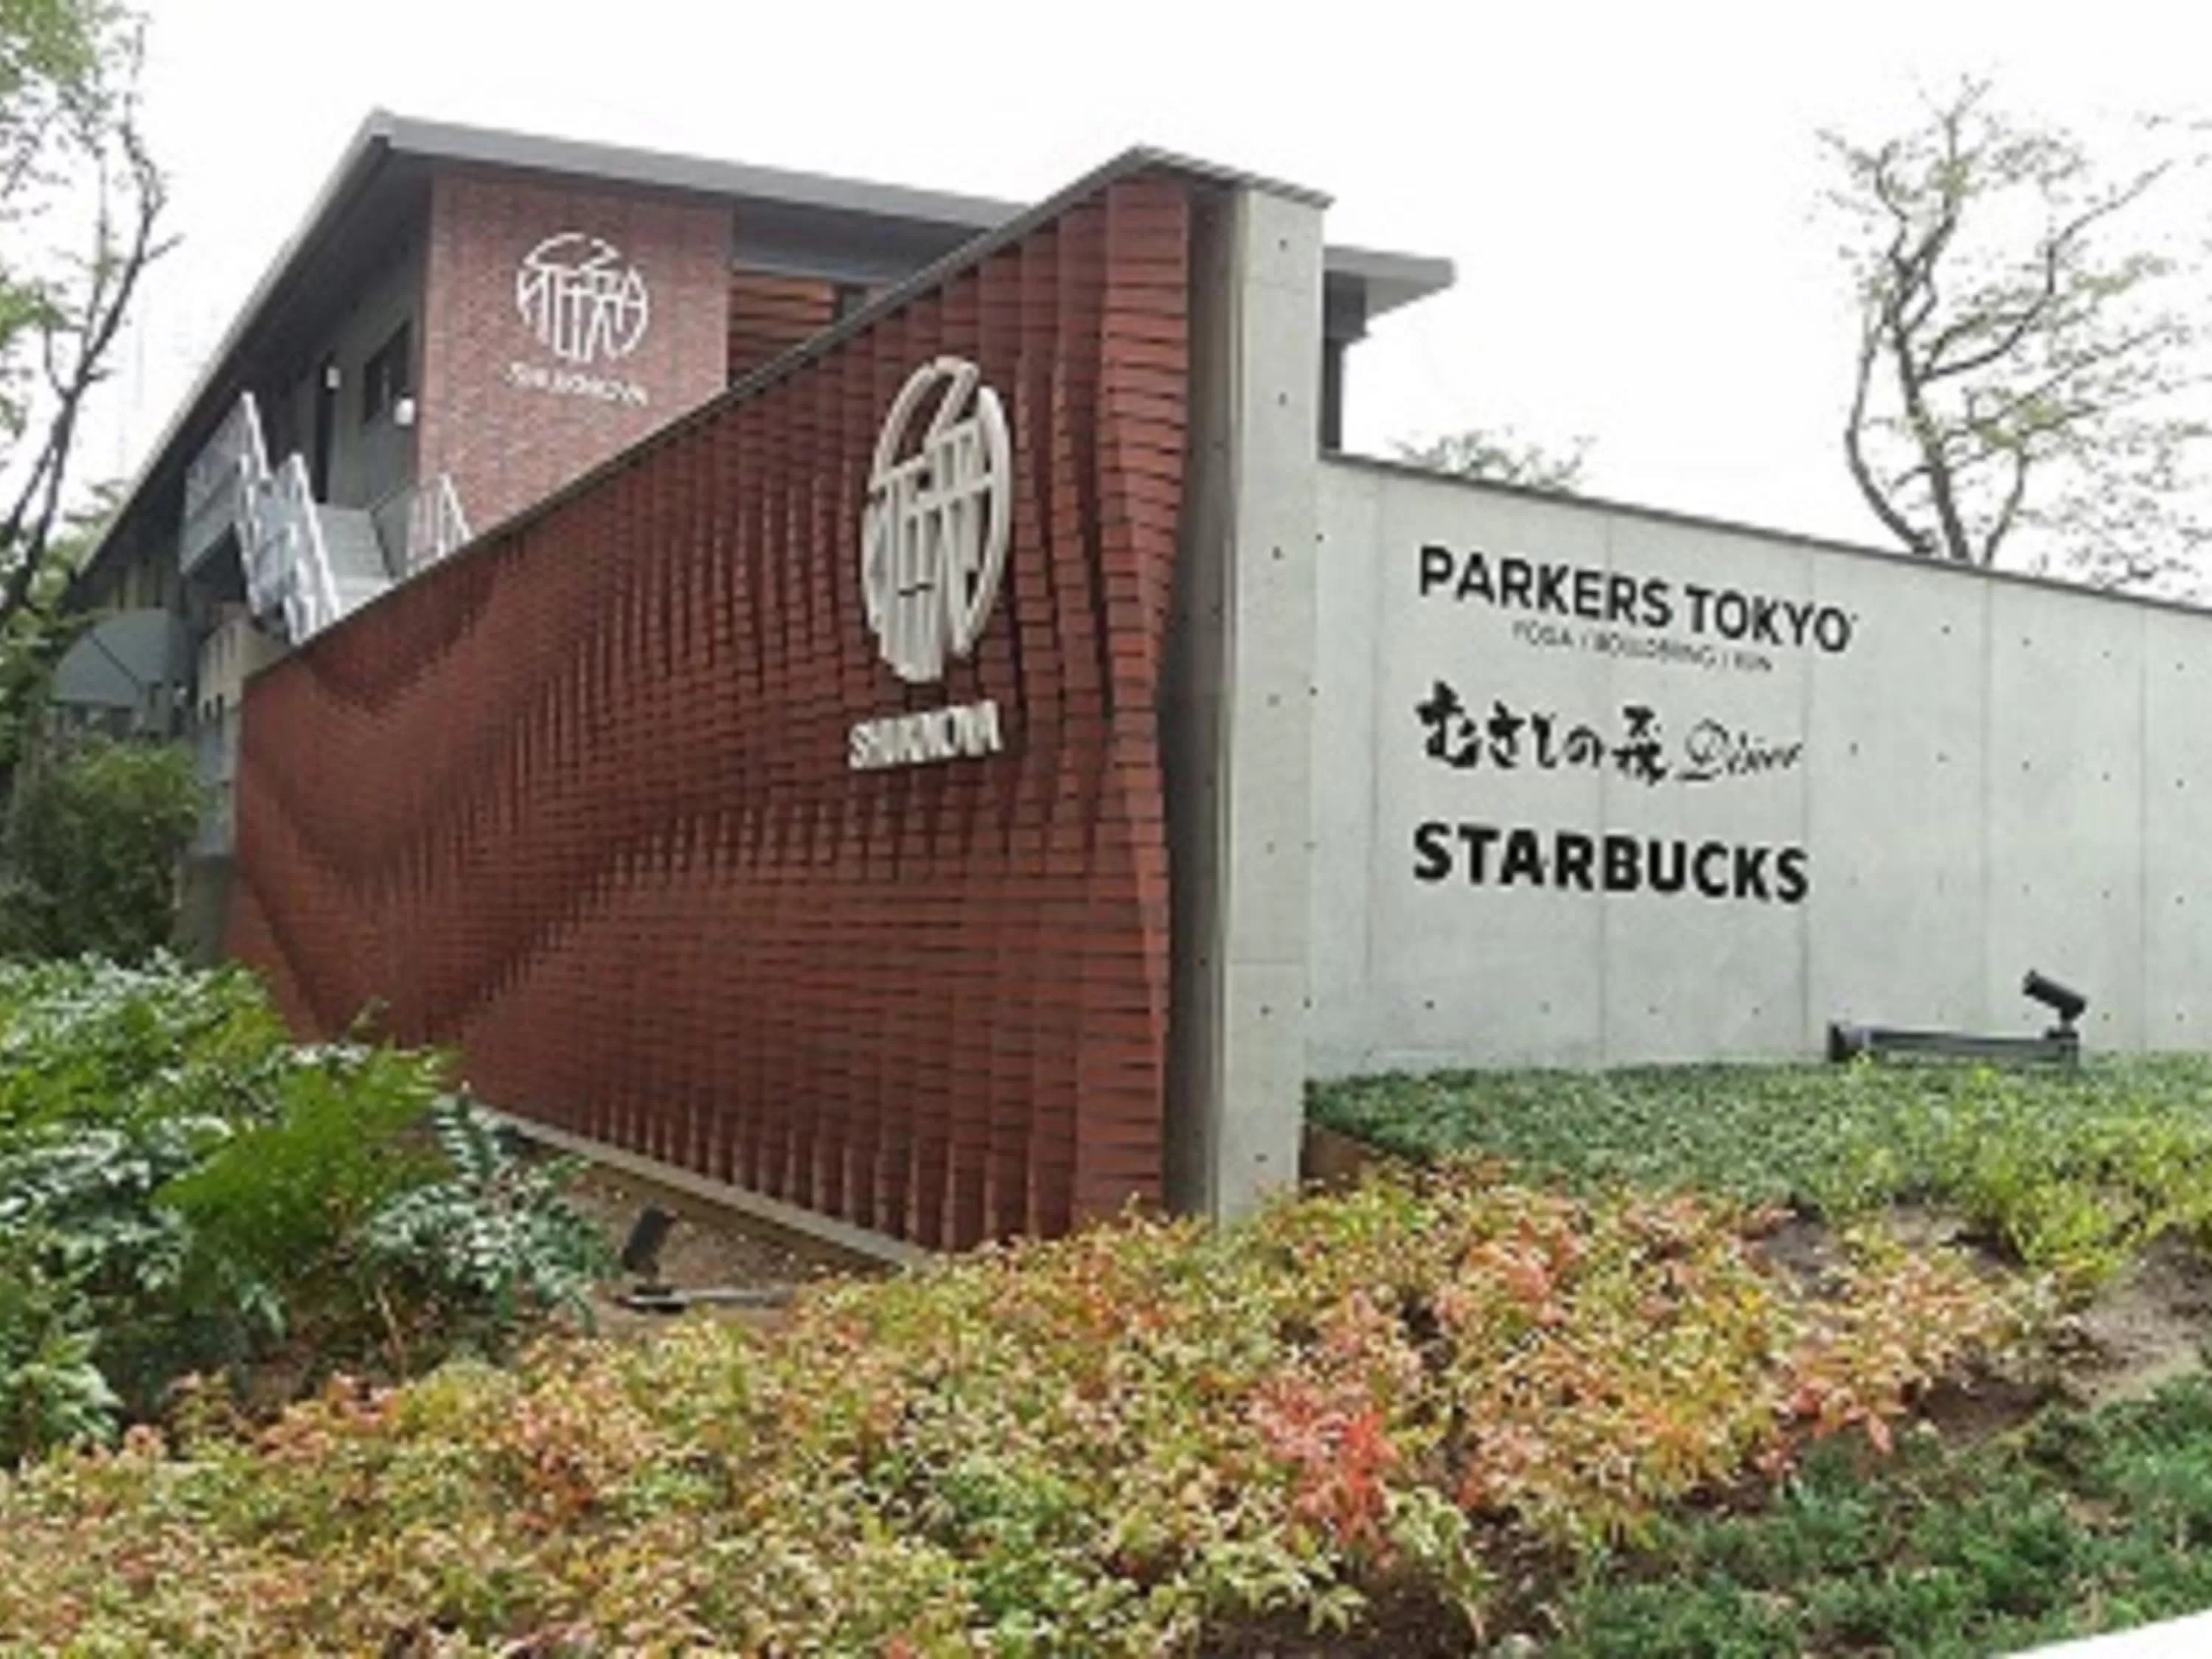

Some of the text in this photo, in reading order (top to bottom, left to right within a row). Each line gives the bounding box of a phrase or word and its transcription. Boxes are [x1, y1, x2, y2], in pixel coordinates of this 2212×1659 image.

[1419, 545, 1851, 653] PARKERS TOKYO
[1413, 821, 1810, 905] STARBUCKS
